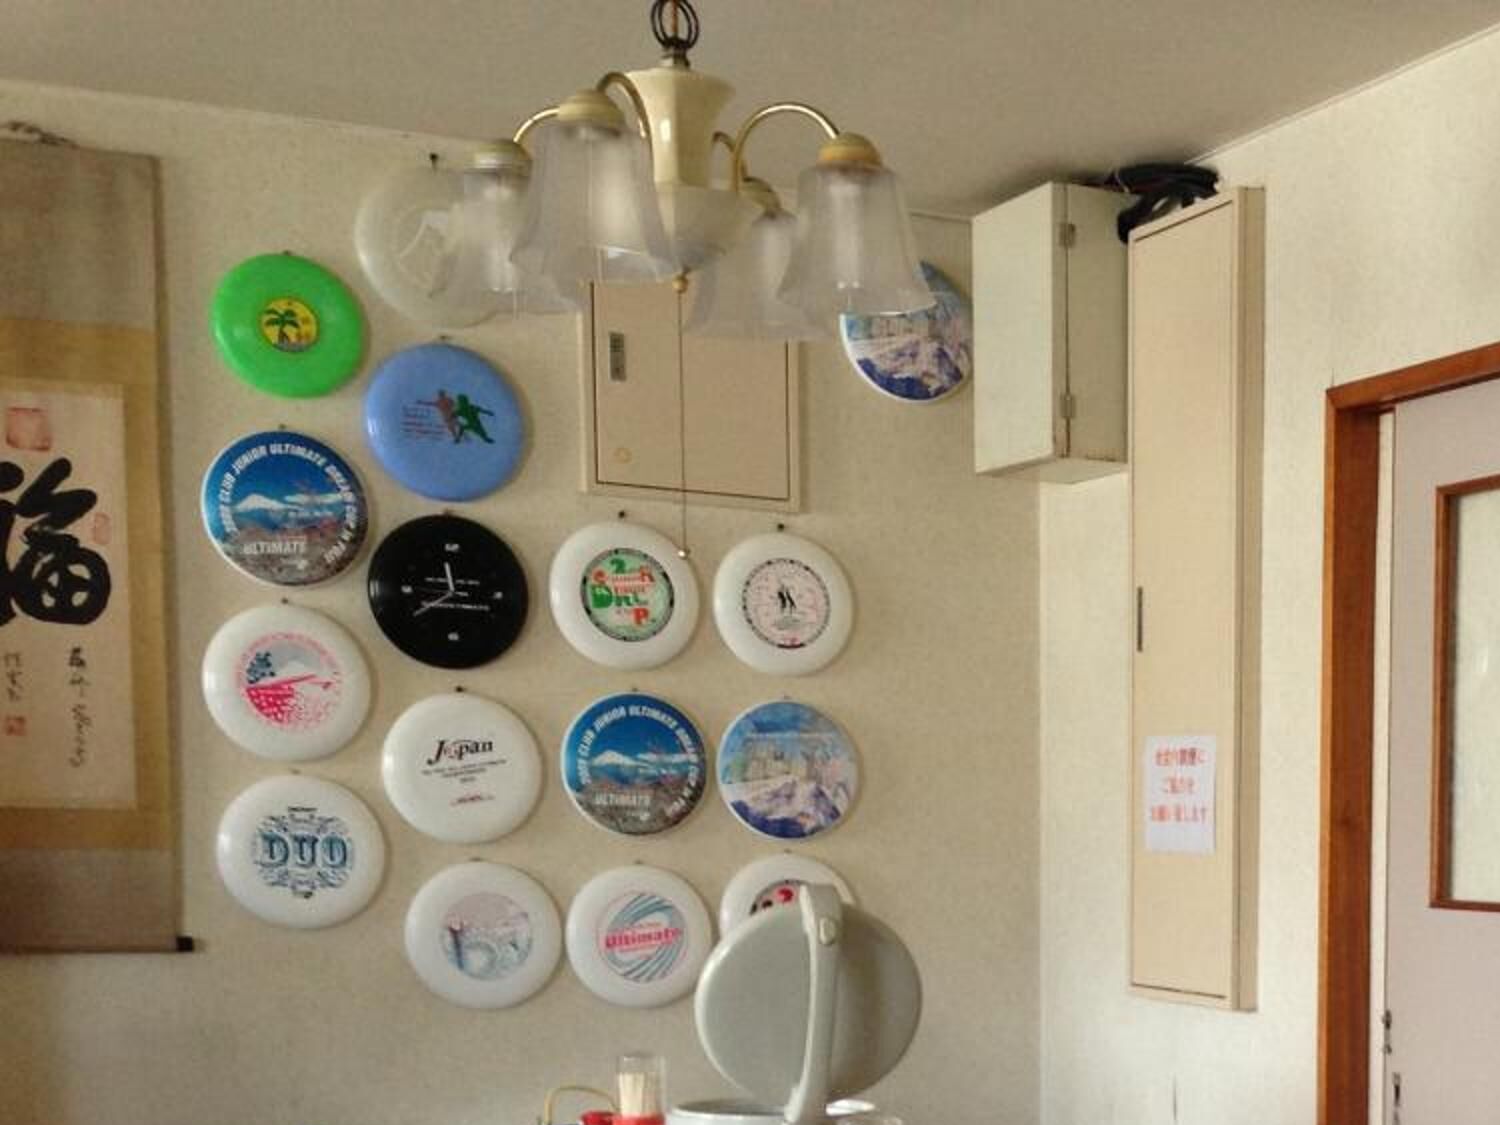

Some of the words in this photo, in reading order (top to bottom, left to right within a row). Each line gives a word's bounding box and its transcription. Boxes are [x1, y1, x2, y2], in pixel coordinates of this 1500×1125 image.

[232, 445, 268, 475] JUNIOR
[269, 443, 327, 466] ULTIMATE
[243, 541, 307, 555] ULTIMATE
[593, 706, 627, 732] JUNIOR
[628, 705, 678, 729] ULTIMATE
[426, 739, 494, 766] Japan
[260, 831, 348, 868] DUO
[605, 927, 683, 949] Ultimate
